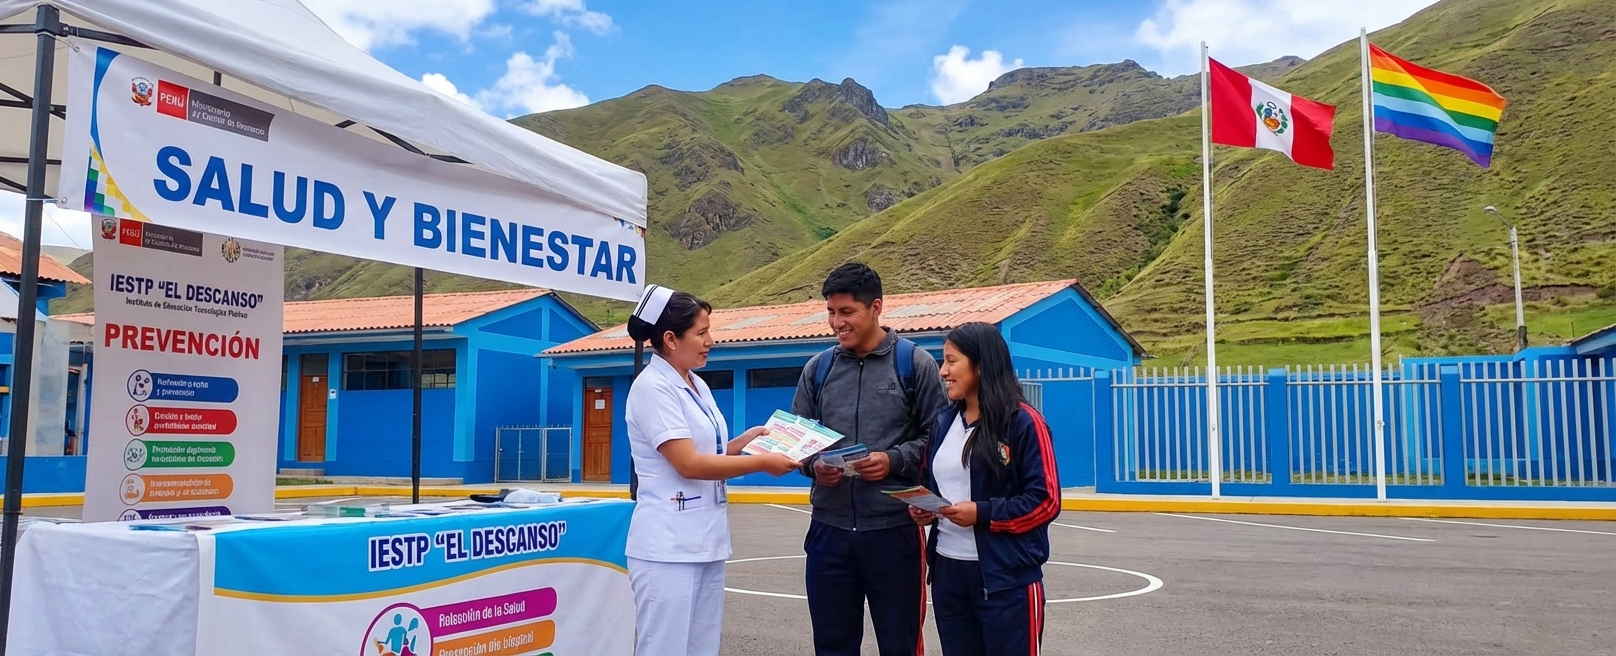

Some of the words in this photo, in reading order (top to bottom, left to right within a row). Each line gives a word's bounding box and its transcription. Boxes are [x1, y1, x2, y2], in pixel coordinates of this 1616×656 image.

[153, 145, 345, 231] SALUD
[362, 190, 397, 240] Y
[413, 202, 637, 285] BIENESTAR
[110, 273, 154, 295] IESTP
[104, 322, 260, 360] PREVENCIÓN
[370, 535, 429, 570] IESTP
[482, 605, 493, 620] de
